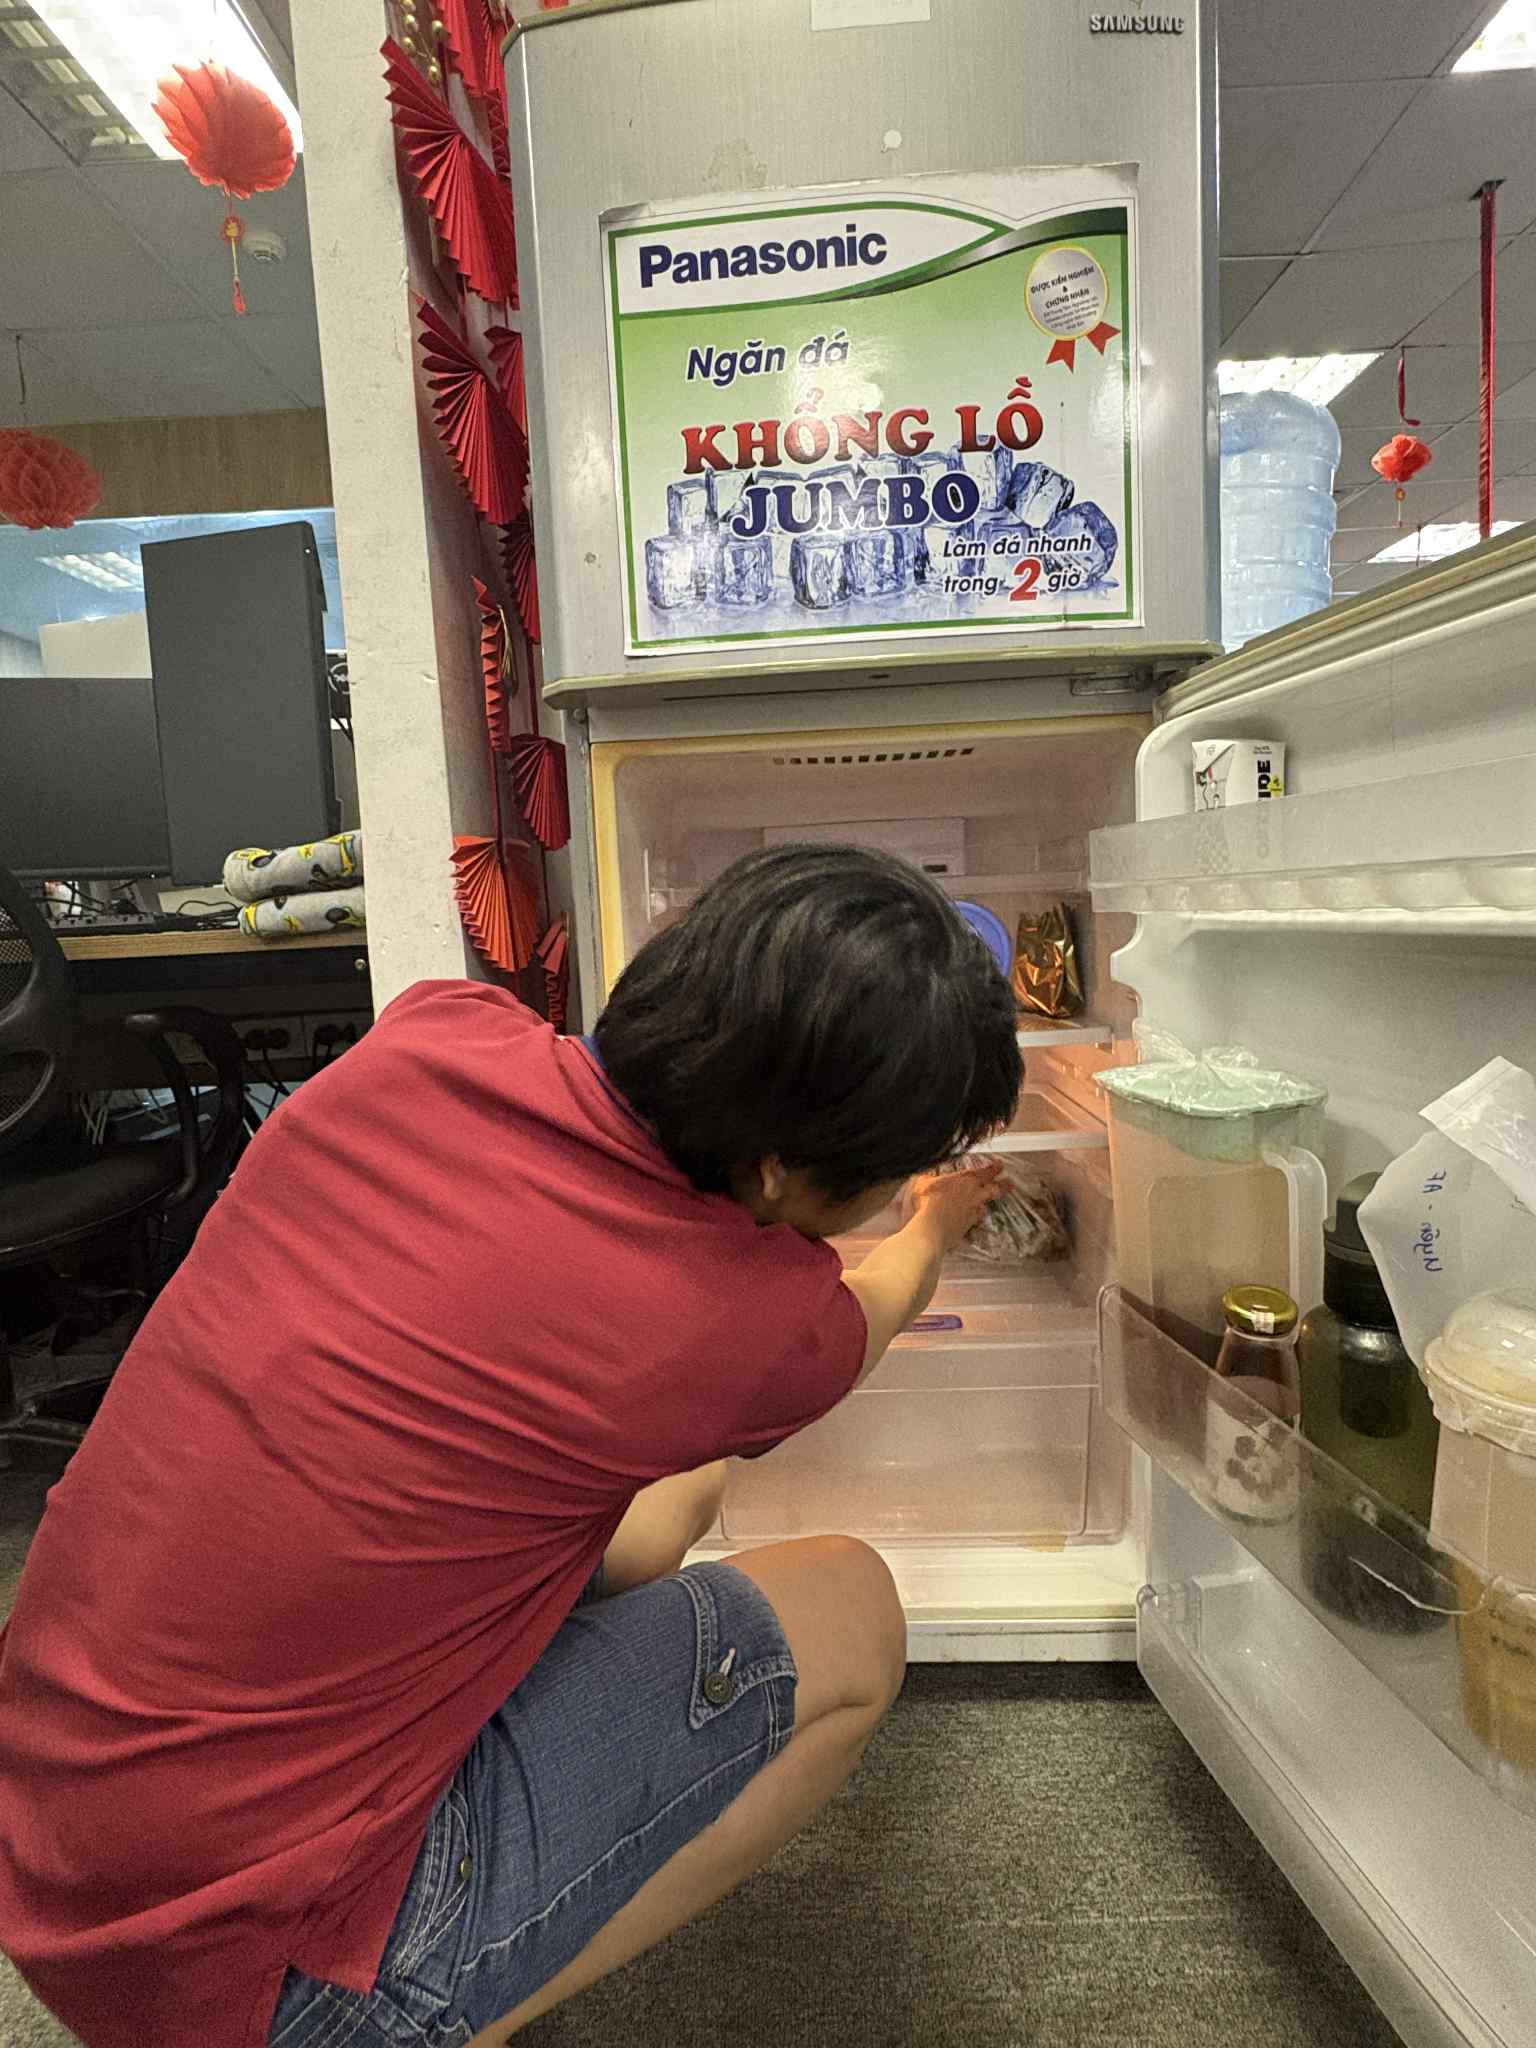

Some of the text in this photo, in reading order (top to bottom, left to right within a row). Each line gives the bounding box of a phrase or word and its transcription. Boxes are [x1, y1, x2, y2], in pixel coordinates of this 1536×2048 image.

[1090, 14, 1184, 33] SAMSUNG
[639, 223, 887, 288] Panasonic
[687, 330, 850, 387] Ngăn đá
[681, 376, 1044, 474] KHỔNG LỒ
[731, 473, 980, 537] JUMBO
[943, 533, 1091, 558] Làm đá nhanh
[944, 558, 1081, 600] trong 2 giờ
